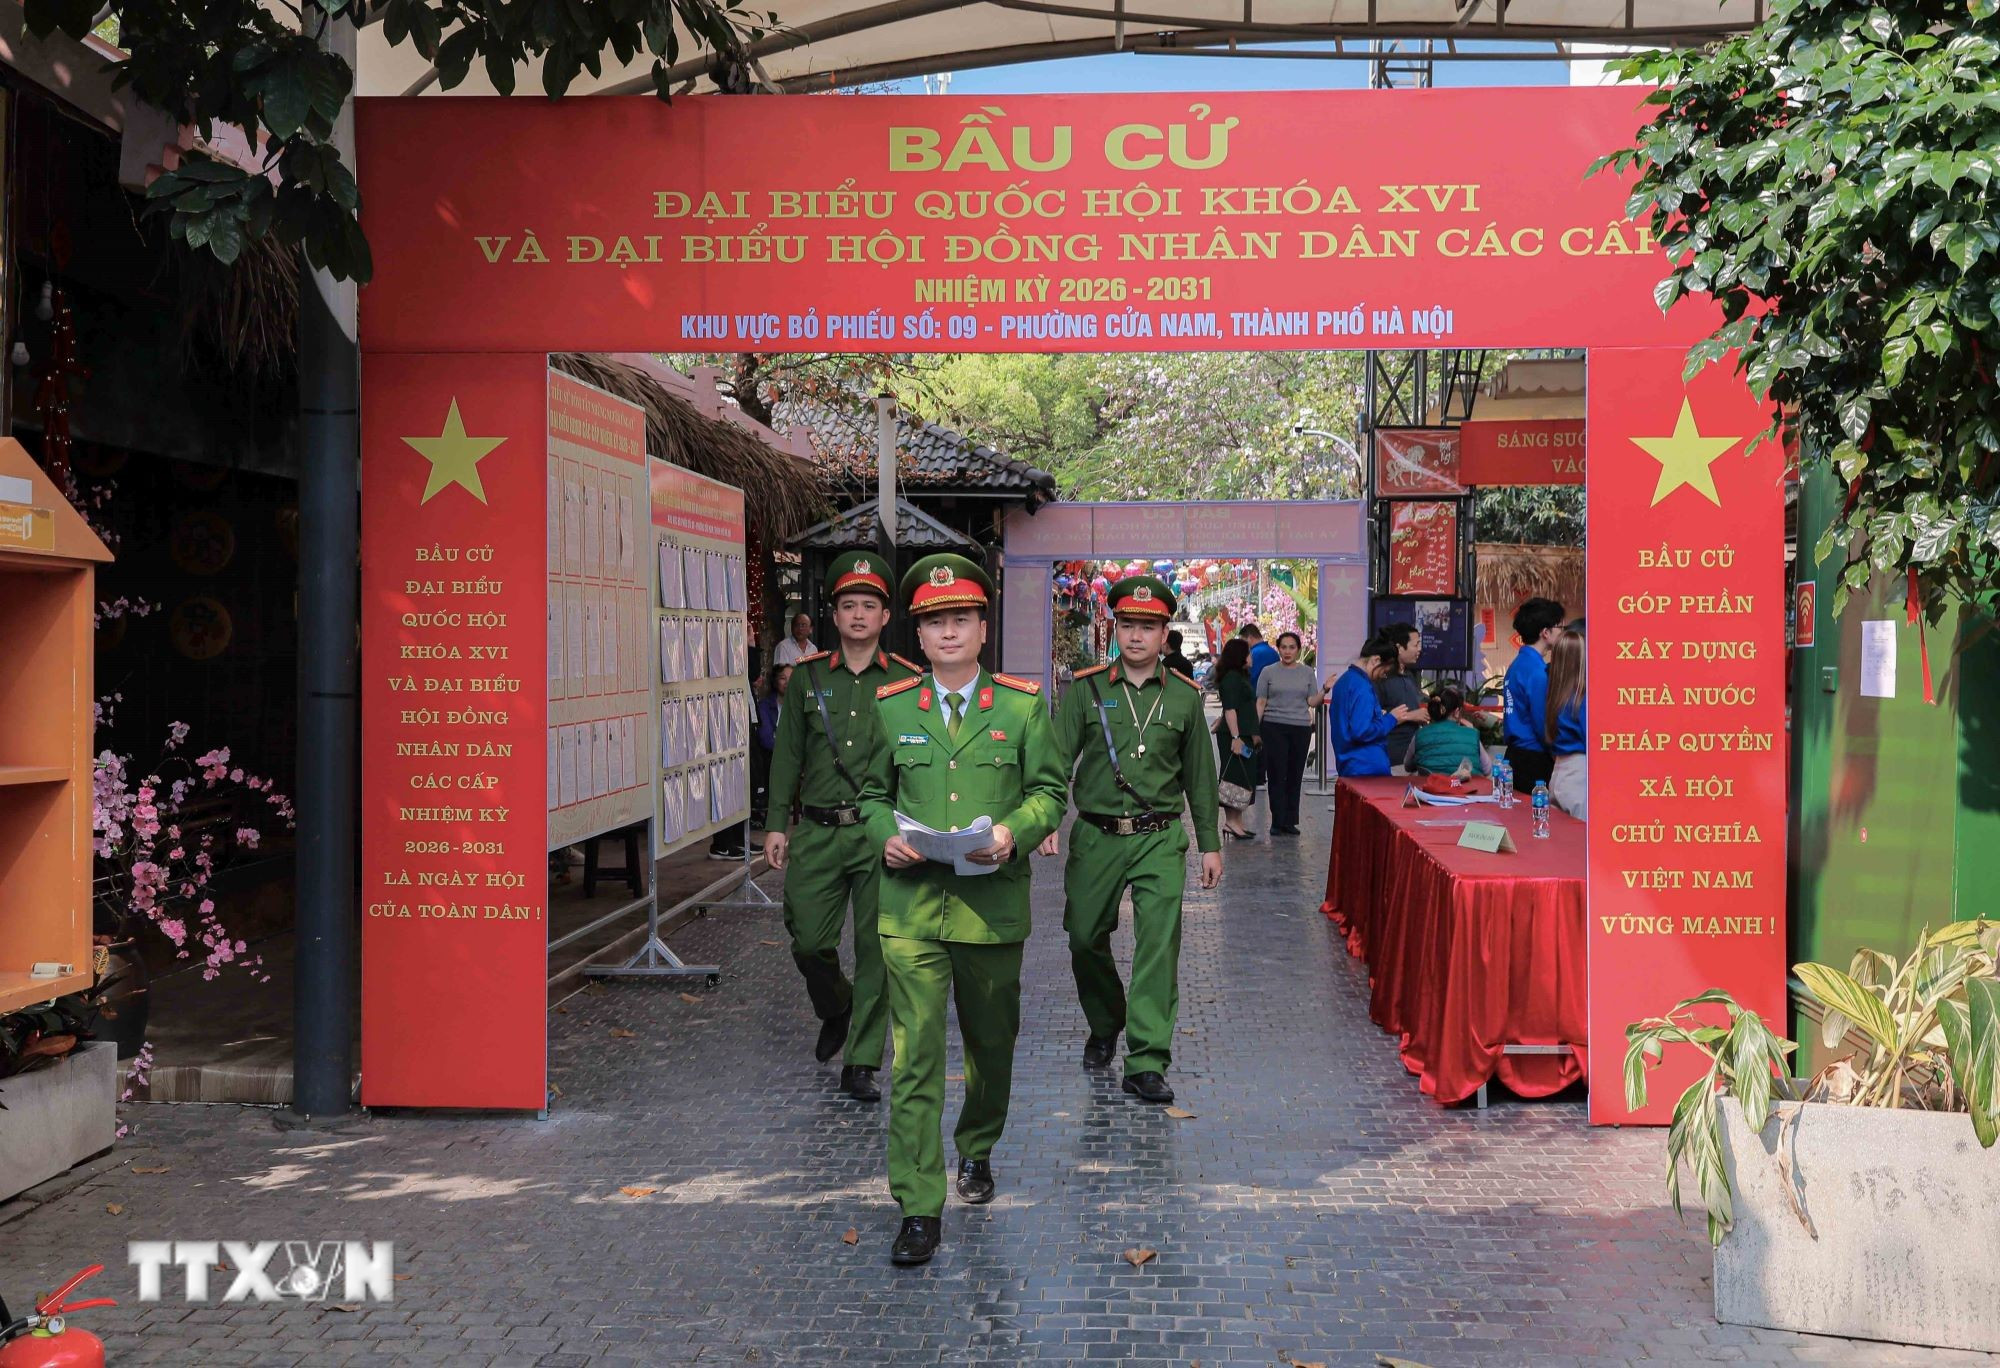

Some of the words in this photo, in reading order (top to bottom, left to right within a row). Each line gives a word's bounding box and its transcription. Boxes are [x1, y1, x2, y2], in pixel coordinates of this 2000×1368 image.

[891, 106, 1073, 173] BẦU
[1105, 103, 1241, 171] CỬ
[654, 191, 750, 224] ĐẠI
[768, 178, 896, 219] BIỂU
[915, 180, 1066, 220] QUỐC
[1082, 182, 1181, 222] HỘI
[1200, 179, 1360, 215] KHÓA
[1378, 184, 1480, 213] XVI
[475, 229, 549, 263] VÀ
[567, 236, 662, 268] ĐẠI
[682, 223, 808, 263] BIỂU
[827, 229, 925, 269] HỘI
[944, 223, 1102, 263] ĐỒNG
[1118, 226, 1281, 261] NHÂN
[1299, 224, 1420, 258] DÂN
[1437, 222, 1543, 258] CÁC
[915, 274, 1005, 307] NHIỆM
[1016, 274, 1050, 302] KỲ
[1060, 278, 1126, 302] 2026
[1147, 277, 1210, 301] 2031
[683, 316, 728, 339] KHU
[736, 314, 781, 344] VỰC
[790, 308, 819, 339] BỎ
[828, 308, 896, 340] PHIẾU
[904, 308, 941, 340] SỐ:
[950, 315, 978, 340] 09
[1002, 309, 1098, 340] PHƯỜNG
[1107, 306, 1153, 338] CỬA
[1162, 314, 1223, 340] NAM,
[1231, 308, 1310, 337] THÀNH
[1318, 304, 1365, 336] PHỐ
[1374, 307, 1405, 335] HÀ
[1413, 307, 1454, 340] NỘI
[1497, 429, 1549, 448] SÁNG
[1553, 429, 1586, 447] SUỐ
[416, 543, 459, 561] BẦU
[466, 544, 494, 561] CỬ
[1639, 542, 1692, 568] BẦU
[1701, 544, 1734, 568] CỬ
[406, 581, 444, 596] ĐẠI
[452, 576, 502, 594] BIỂU
[1618, 592, 1671, 614] GÓP
[1680, 588, 1753, 613] PHẦN
[402, 609, 461, 627] QUỐC
[467, 611, 506, 629] HỘI
[400, 643, 462, 659] KHÓA
[469, 646, 508, 659] XVI
[1616, 638, 1673, 659] XÂY
[1682, 641, 1756, 662] DỰNG
[388, 675, 417, 691] VÀ
[424, 679, 462, 694] ĐẠI
[470, 674, 520, 692] BIỂU
[1618, 684, 1675, 705] NHÀ
[1684, 683, 1755, 705] NƯỚC
[401, 708, 440, 726] HỘI
[447, 706, 508, 724] ĐỒNG
[397, 741, 459, 757] NHÂN
[467, 741, 512, 757] DÂN
[1601, 730, 1670, 751] PHÁP
[1679, 726, 1773, 752] QUYỀN
[411, 773, 451, 789] CÁC
[458, 772, 499, 789] CẤP
[1640, 776, 1677, 797] XÃ
[1686, 776, 1733, 800] HỘI
[400, 805, 472, 823] NHIỆM
[479, 806, 509, 822] KỲ
[1612, 820, 1665, 843] CHỦ
[1674, 822, 1761, 843] NGHĨA
[405, 841, 449, 855] 2026
[461, 841, 504, 855] 2031
[384, 869, 412, 886] LÀ
[418, 870, 479, 887] NGÀY
[486, 871, 524, 889] HỘI
[1622, 867, 1684, 891] VIỆT
[1693, 871, 1753, 889] NAM
[369, 900, 411, 918] CỦA
[418, 902, 477, 919] TOÀN
[484, 904, 530, 919] DÂN
[1600, 913, 1674, 935] VỮNG
[1682, 917, 1762, 938] MẠNH
